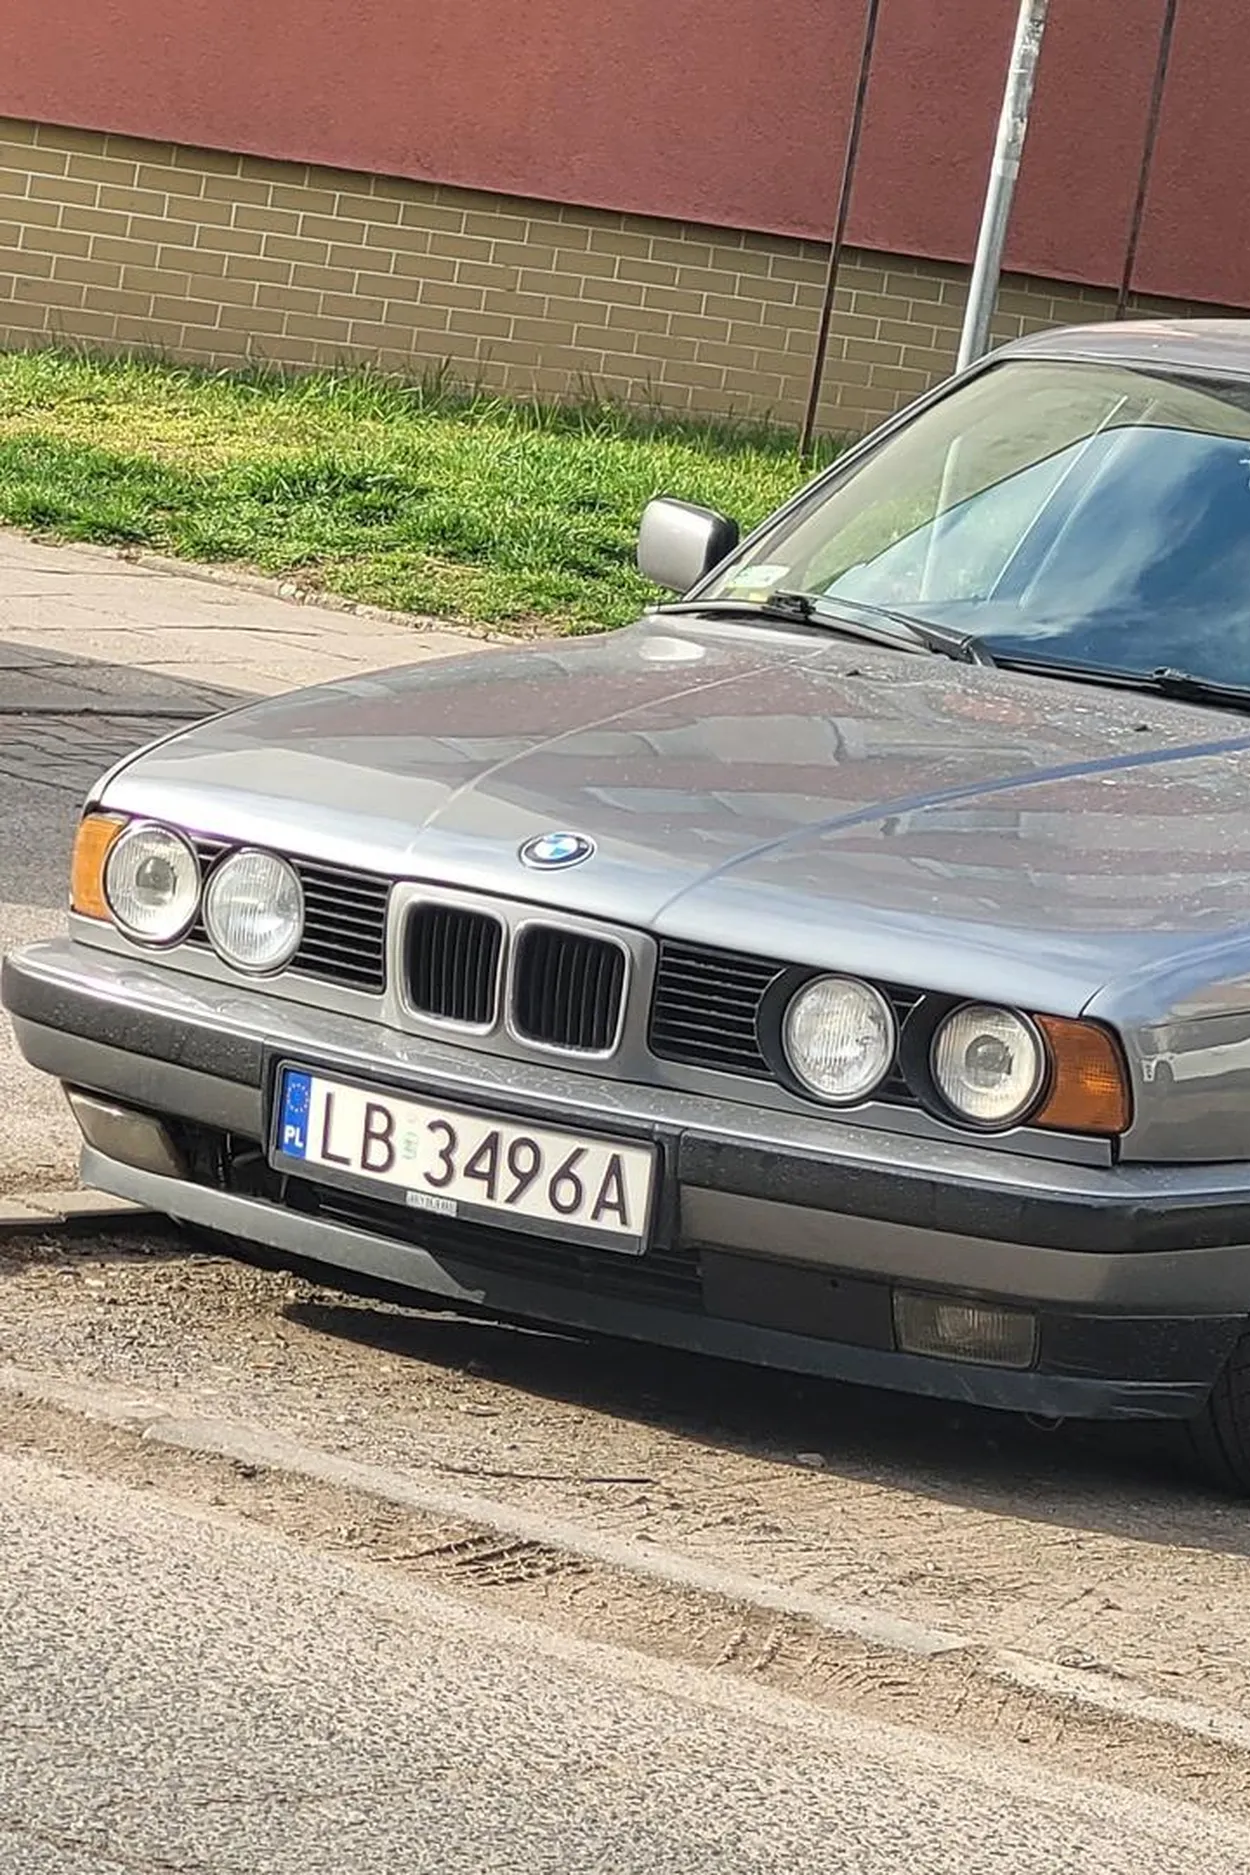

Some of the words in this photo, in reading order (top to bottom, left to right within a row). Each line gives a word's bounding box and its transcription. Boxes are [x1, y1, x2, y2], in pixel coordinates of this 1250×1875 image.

[284, 1124, 304, 1148] PL
[320, 1092, 396, 1174] LB
[423, 1119, 630, 1227] 3496A
